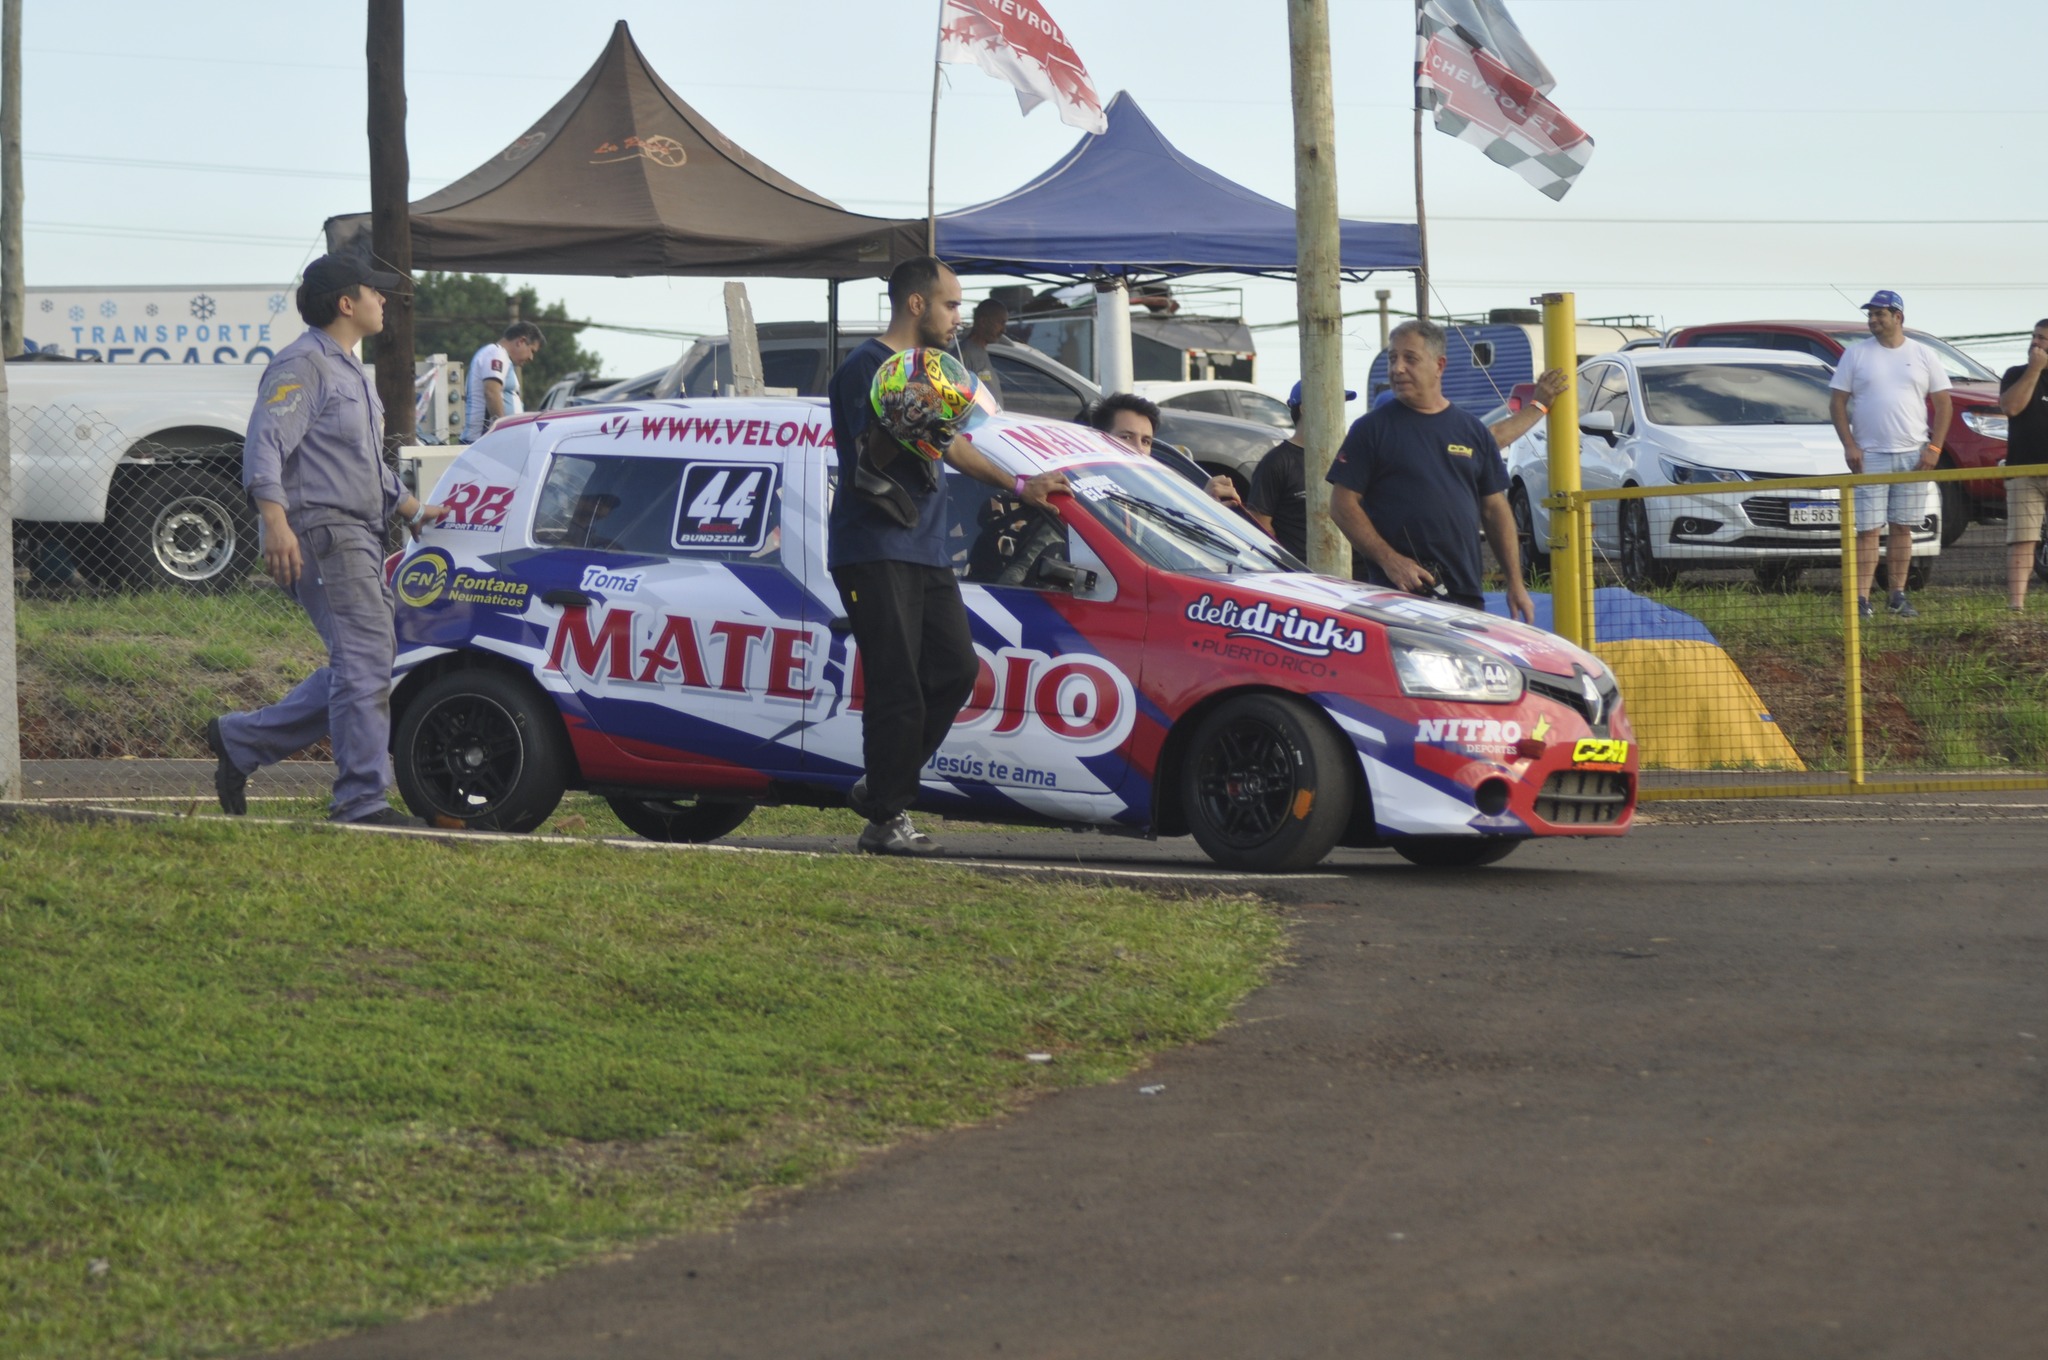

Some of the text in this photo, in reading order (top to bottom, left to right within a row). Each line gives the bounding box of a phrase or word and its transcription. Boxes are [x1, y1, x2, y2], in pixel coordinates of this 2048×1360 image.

[1431, 55, 1560, 136] CHEVROLET
[71, 324, 272, 344] TRANSPORTE
[434, 480, 516, 526] RB
[687, 470, 762, 529] 44
[1793, 509, 1808, 522] AC
[1811, 509, 1834, 522] 563
[443, 522, 497, 532] SPORT TEAM
[681, 534, 747, 543] BUNDZIAK
[404, 572, 434, 586] FN
[453, 574, 529, 595] Fontana
[584, 569, 642, 592] Tomá
[448, 590, 524, 608] Neumáticos
[1187, 594, 1364, 653] delidrinks
[543, 605, 817, 702] MATE
[1201, 639, 1327, 678] PUERTO RICO
[1485, 665, 1507, 684] 44
[1414, 719, 1522, 744] NITRO
[1466, 743, 1517, 755] DEPORTES
[927, 751, 1057, 788] Jesús te ama
